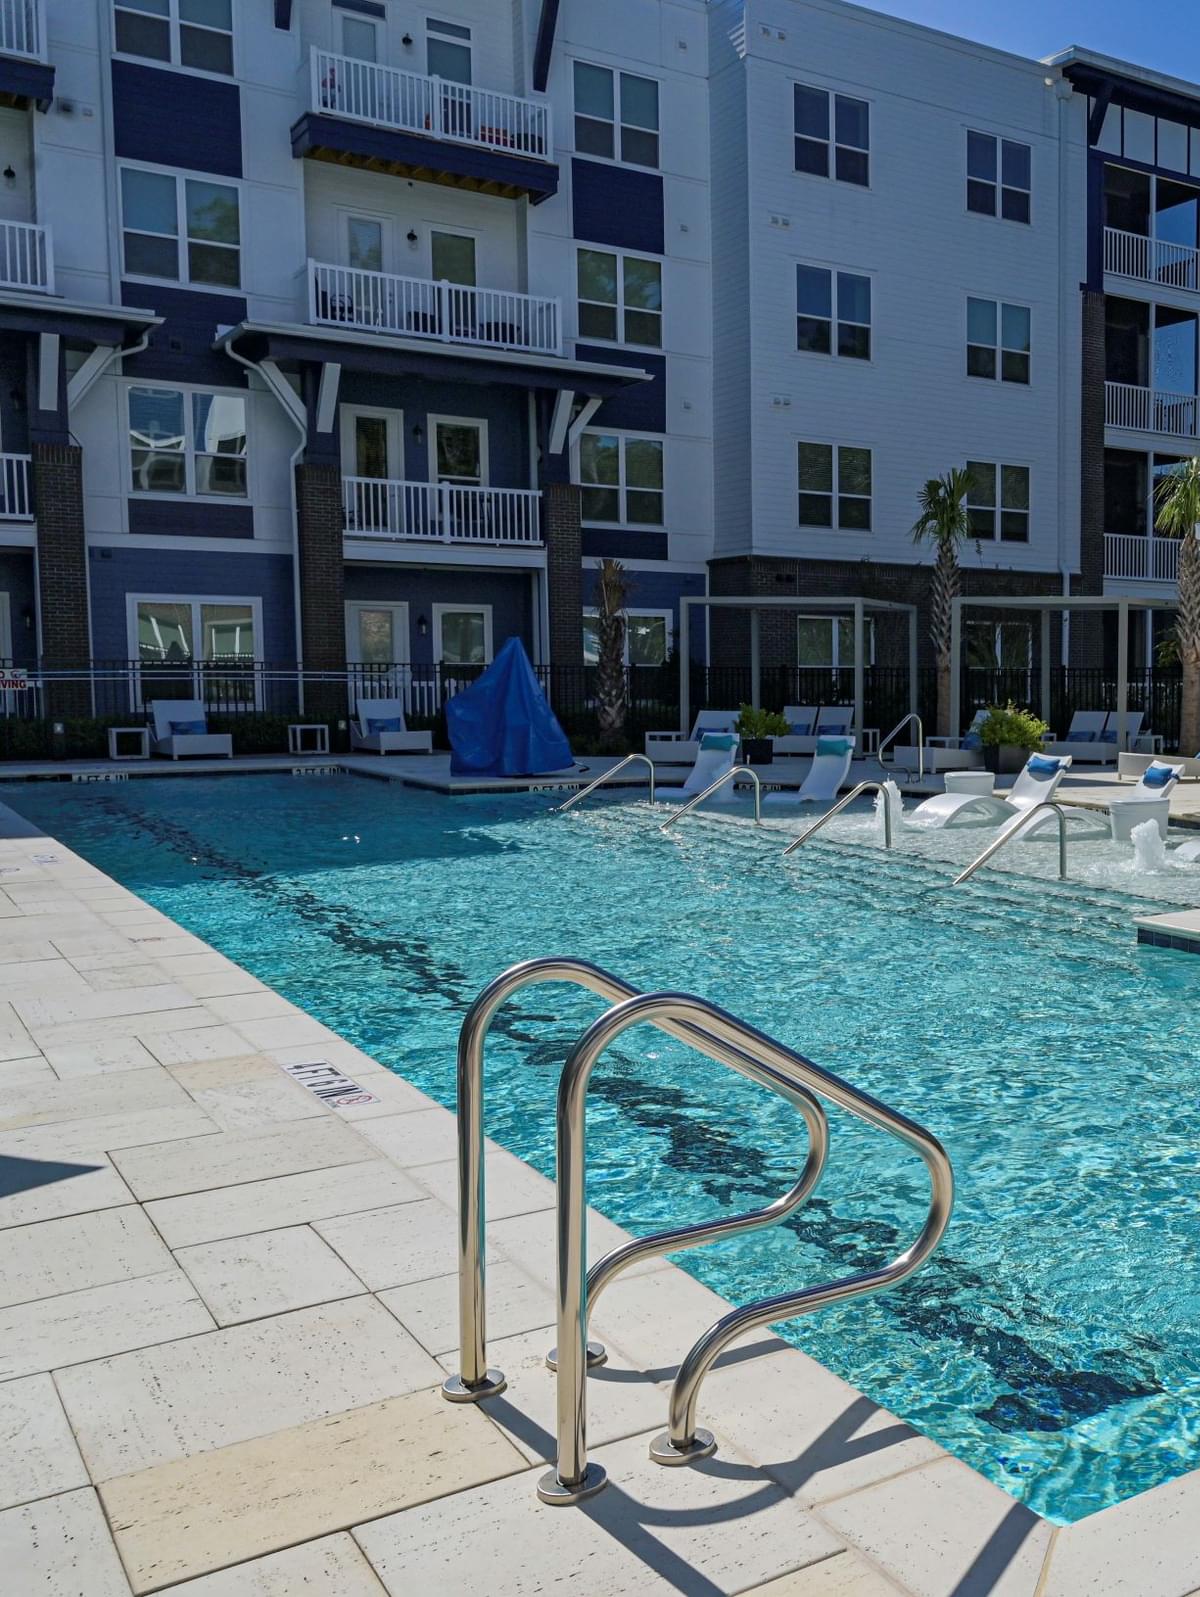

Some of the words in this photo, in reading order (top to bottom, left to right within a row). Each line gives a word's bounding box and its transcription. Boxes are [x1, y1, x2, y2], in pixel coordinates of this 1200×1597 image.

[0, 680, 26, 688] VING
[291, 1067, 341, 1081] FT
[313, 1084, 363, 1099] IN
